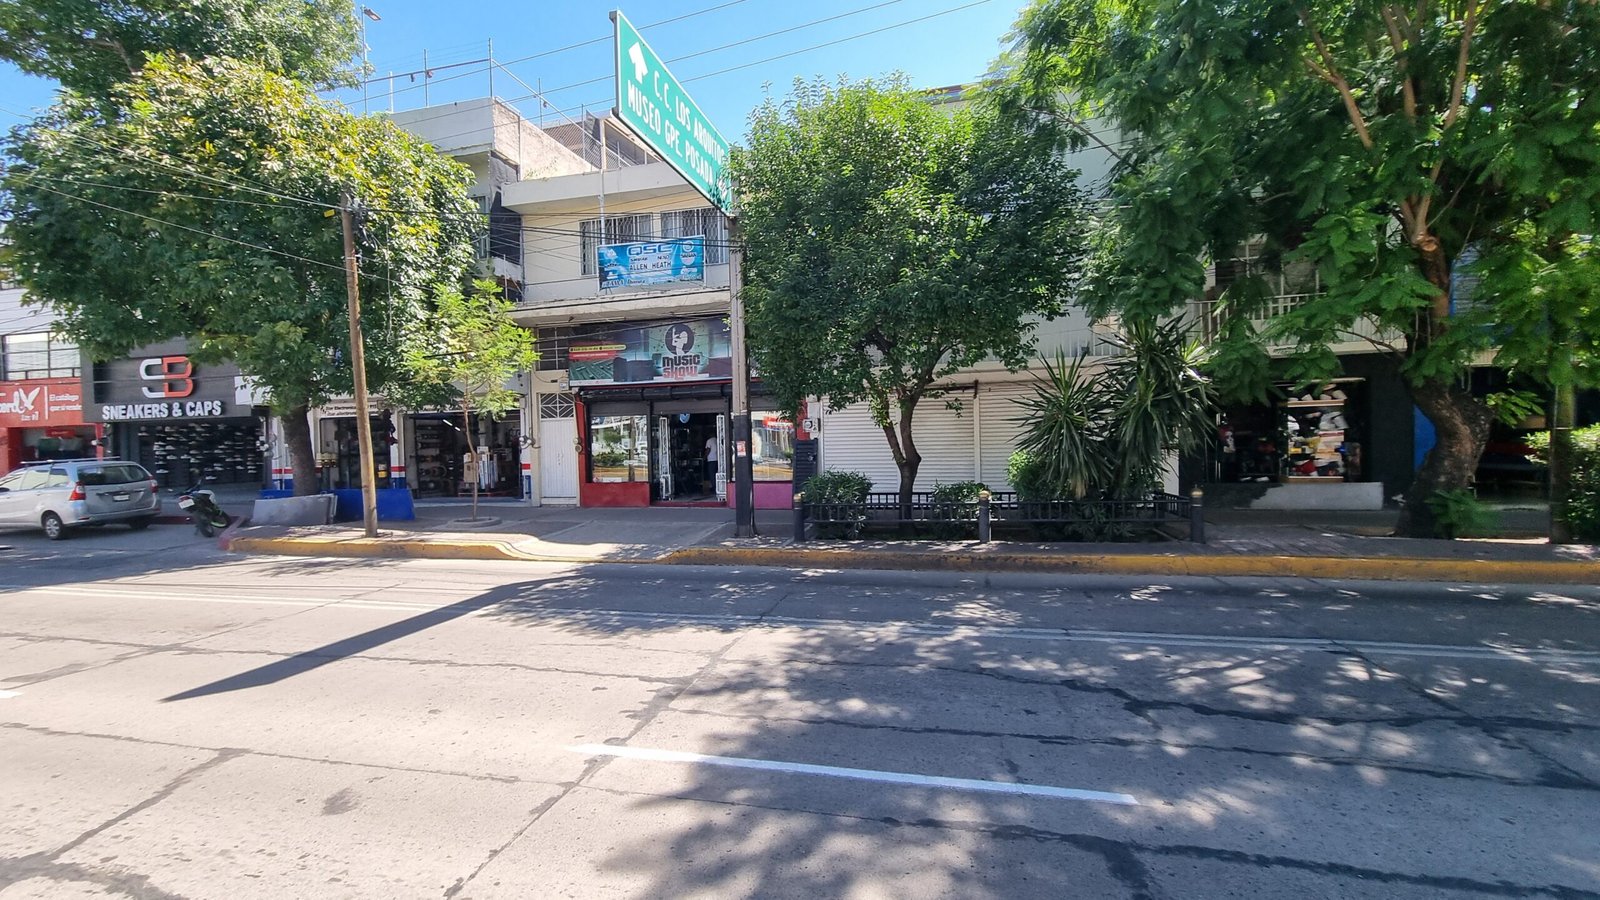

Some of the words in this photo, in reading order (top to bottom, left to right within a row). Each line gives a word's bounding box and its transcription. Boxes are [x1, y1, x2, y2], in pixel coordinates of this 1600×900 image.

[675, 95, 691, 132] LOS
[627, 79, 661, 136] MUSEO
[664, 119, 683, 158] GPE.
[685, 140, 713, 186] POSADA
[627, 243, 674, 256] QSC
[629, 264, 648, 272] ALLEN
[652, 261, 672, 269] HEATH
[102, 403, 168, 420] SNEAKERS
[172, 401, 182, 417] &
[185, 400, 222, 417] CAPS
